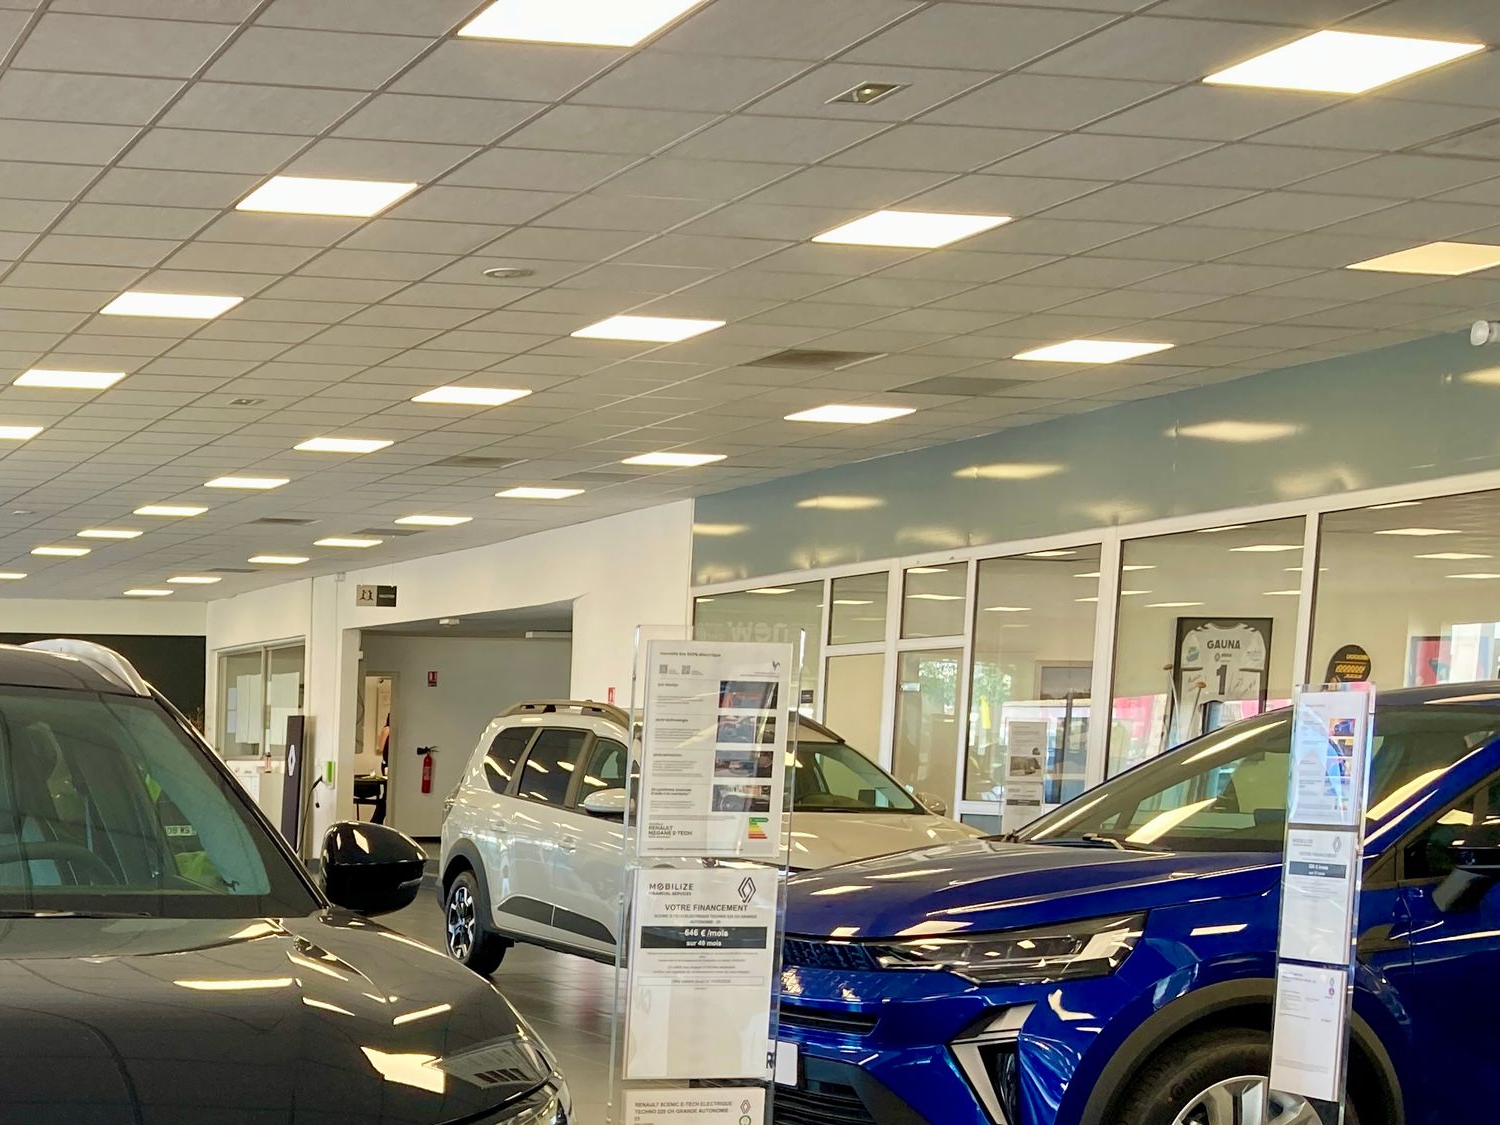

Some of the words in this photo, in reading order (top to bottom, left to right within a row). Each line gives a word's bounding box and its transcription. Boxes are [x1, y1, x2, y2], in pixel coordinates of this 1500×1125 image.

[1206, 640, 1241, 650] GAUNA
[1216, 664, 1228, 696] 1
[649, 882, 693, 891] MOBILIZE
[693, 904, 749, 912] FINANCEMENT
